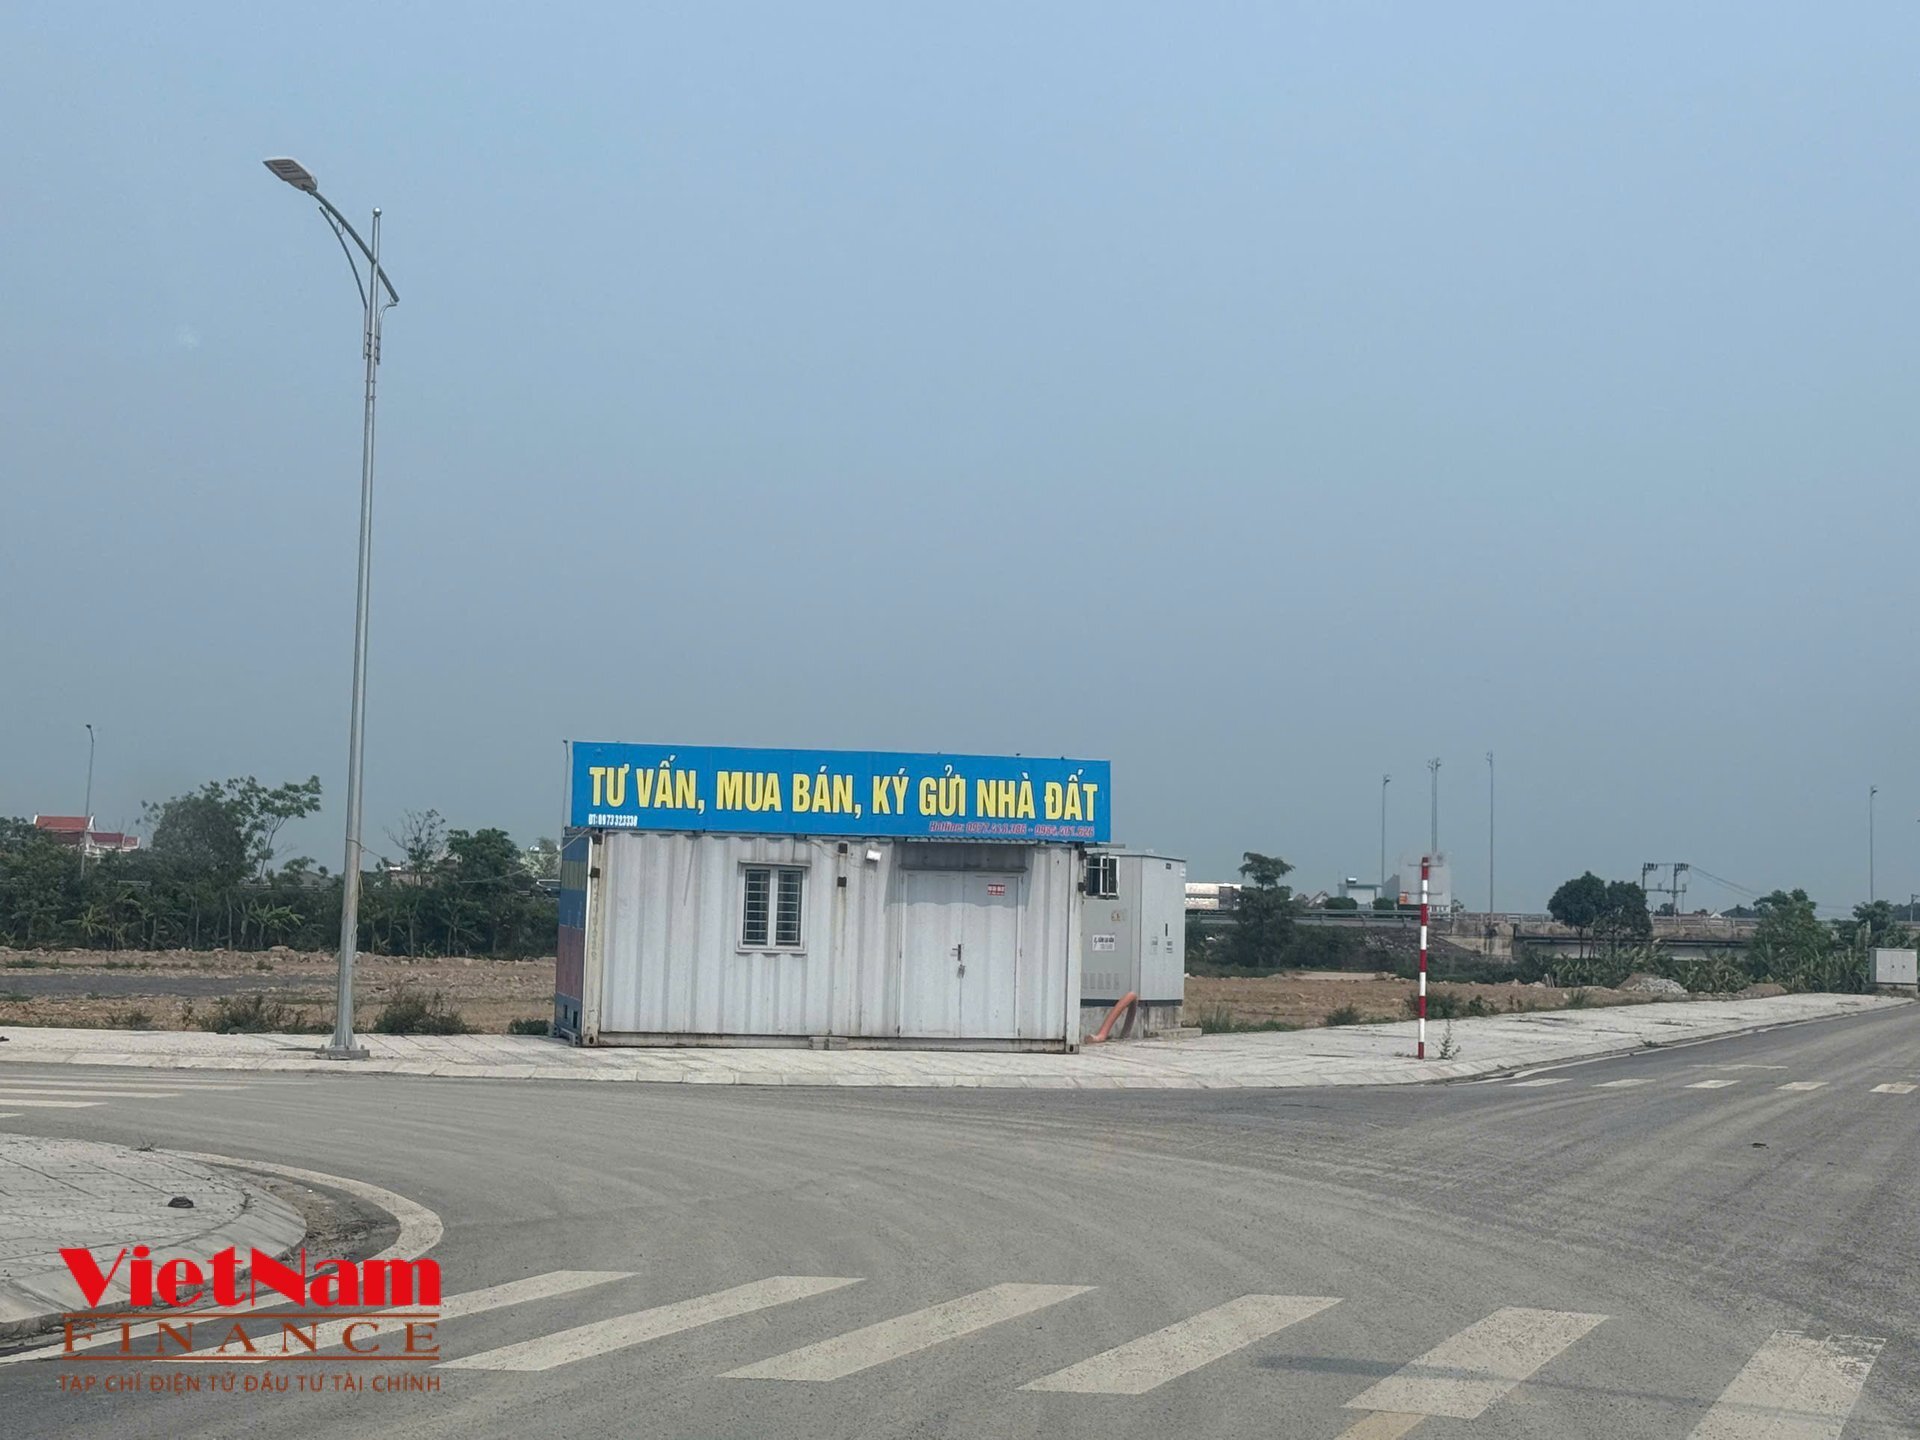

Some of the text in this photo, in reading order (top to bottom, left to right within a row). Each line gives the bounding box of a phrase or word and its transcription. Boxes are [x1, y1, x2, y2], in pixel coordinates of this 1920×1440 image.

[588, 754, 1099, 822] TƯ VẤN, MUA BÁN, KÝ GỬI NHÀ ĐẤT
